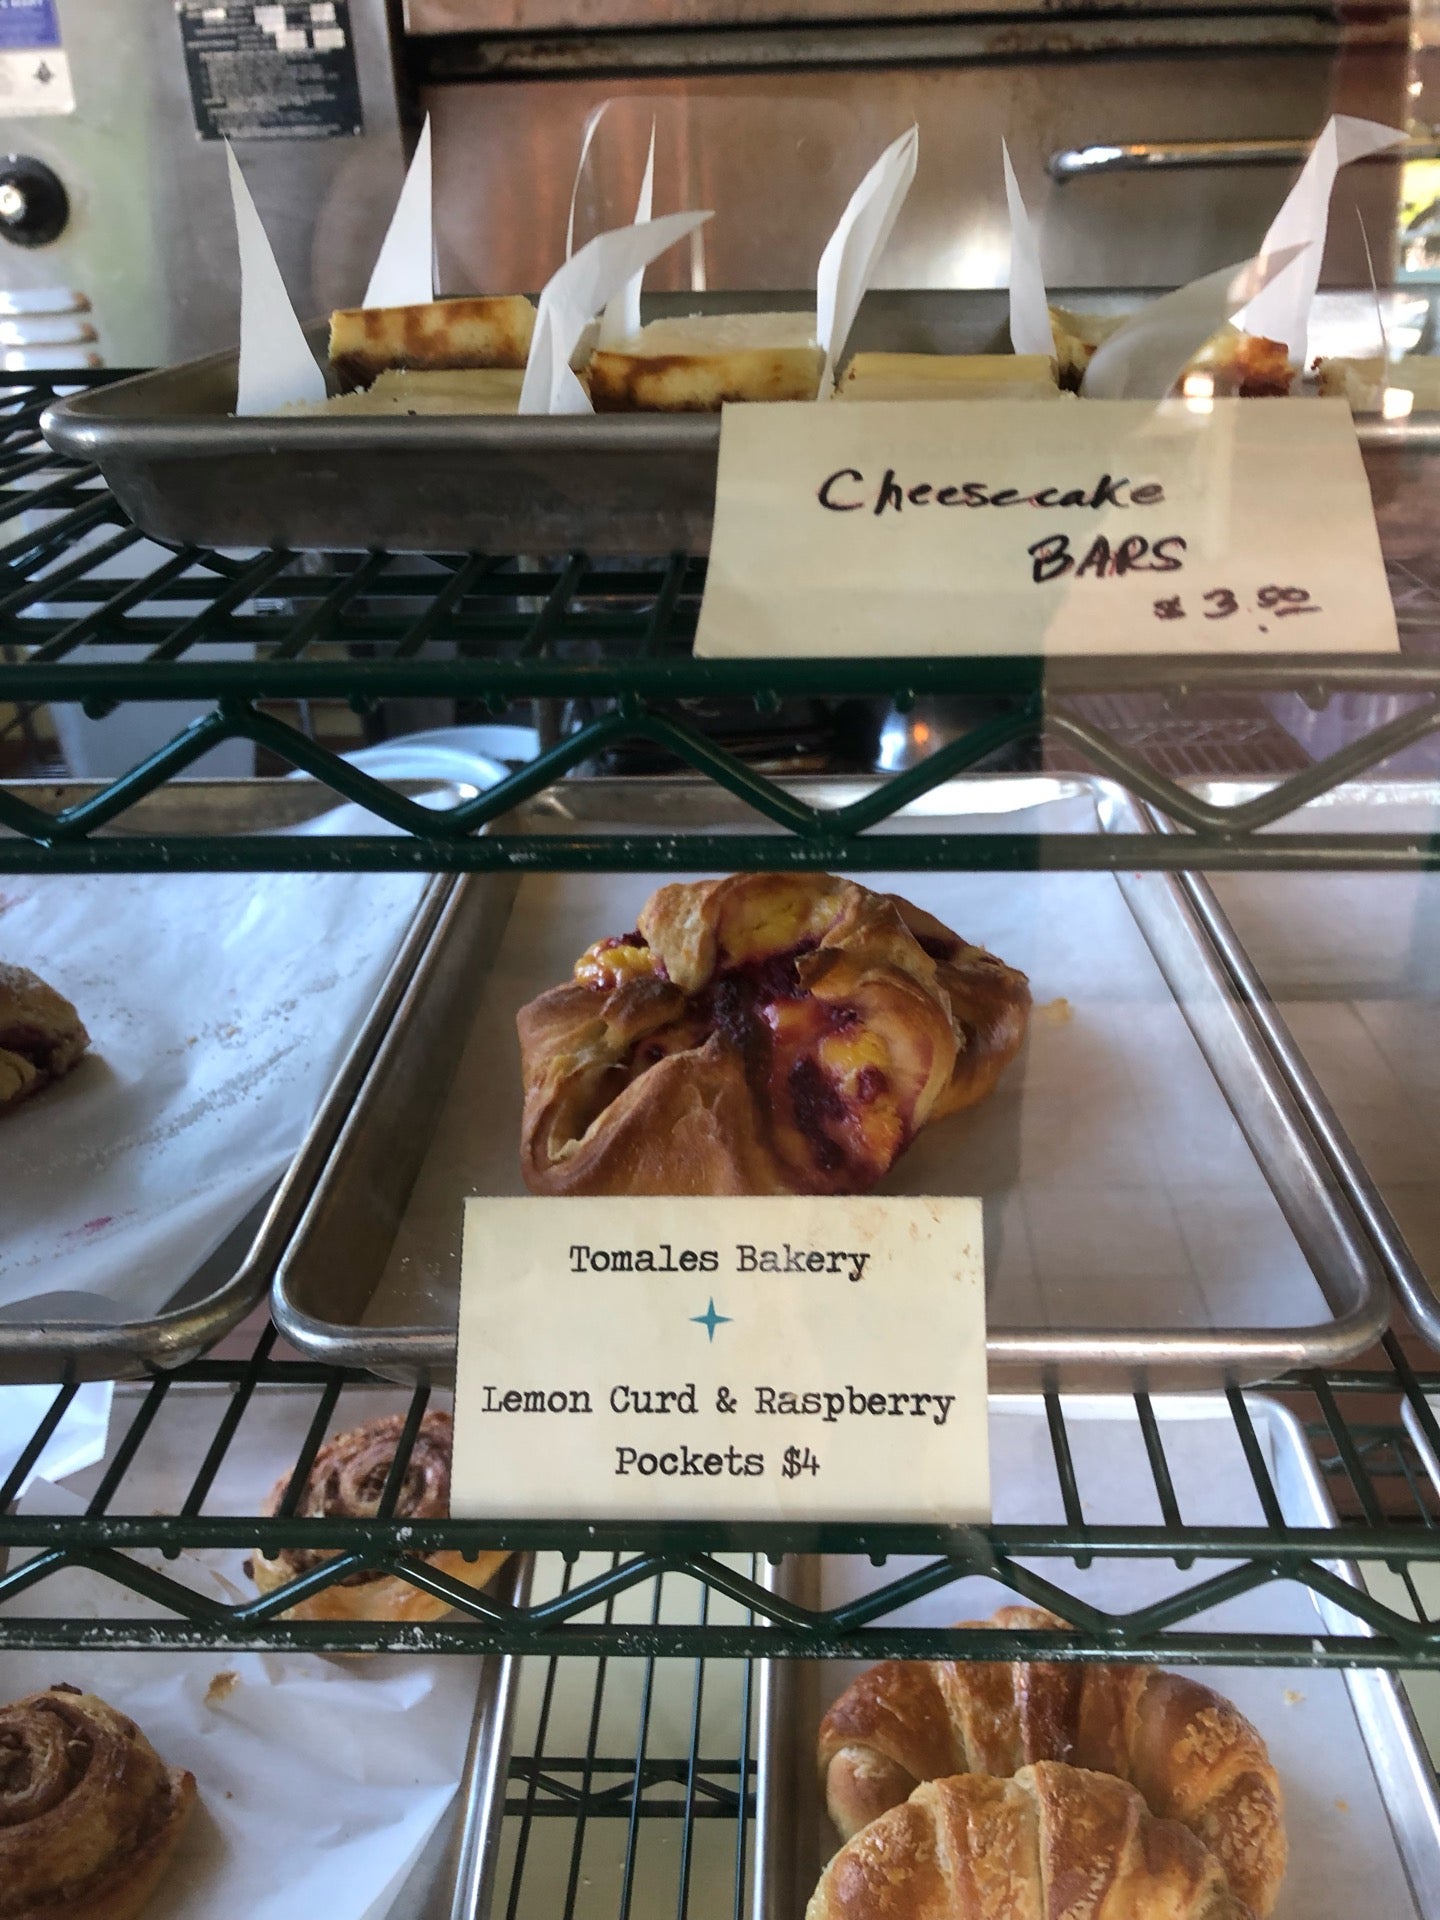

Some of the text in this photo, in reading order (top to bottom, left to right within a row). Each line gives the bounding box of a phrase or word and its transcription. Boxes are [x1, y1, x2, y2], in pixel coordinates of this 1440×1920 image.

[817, 469, 1166, 516] Cheesecake
[1028, 535, 1188, 583] BARS
[569, 1243, 871, 1281] Tomales Bakery
[481, 1383, 956, 1425] Lemon Curd & Raspberry
[615, 1445, 820, 1479] Pockets $4
